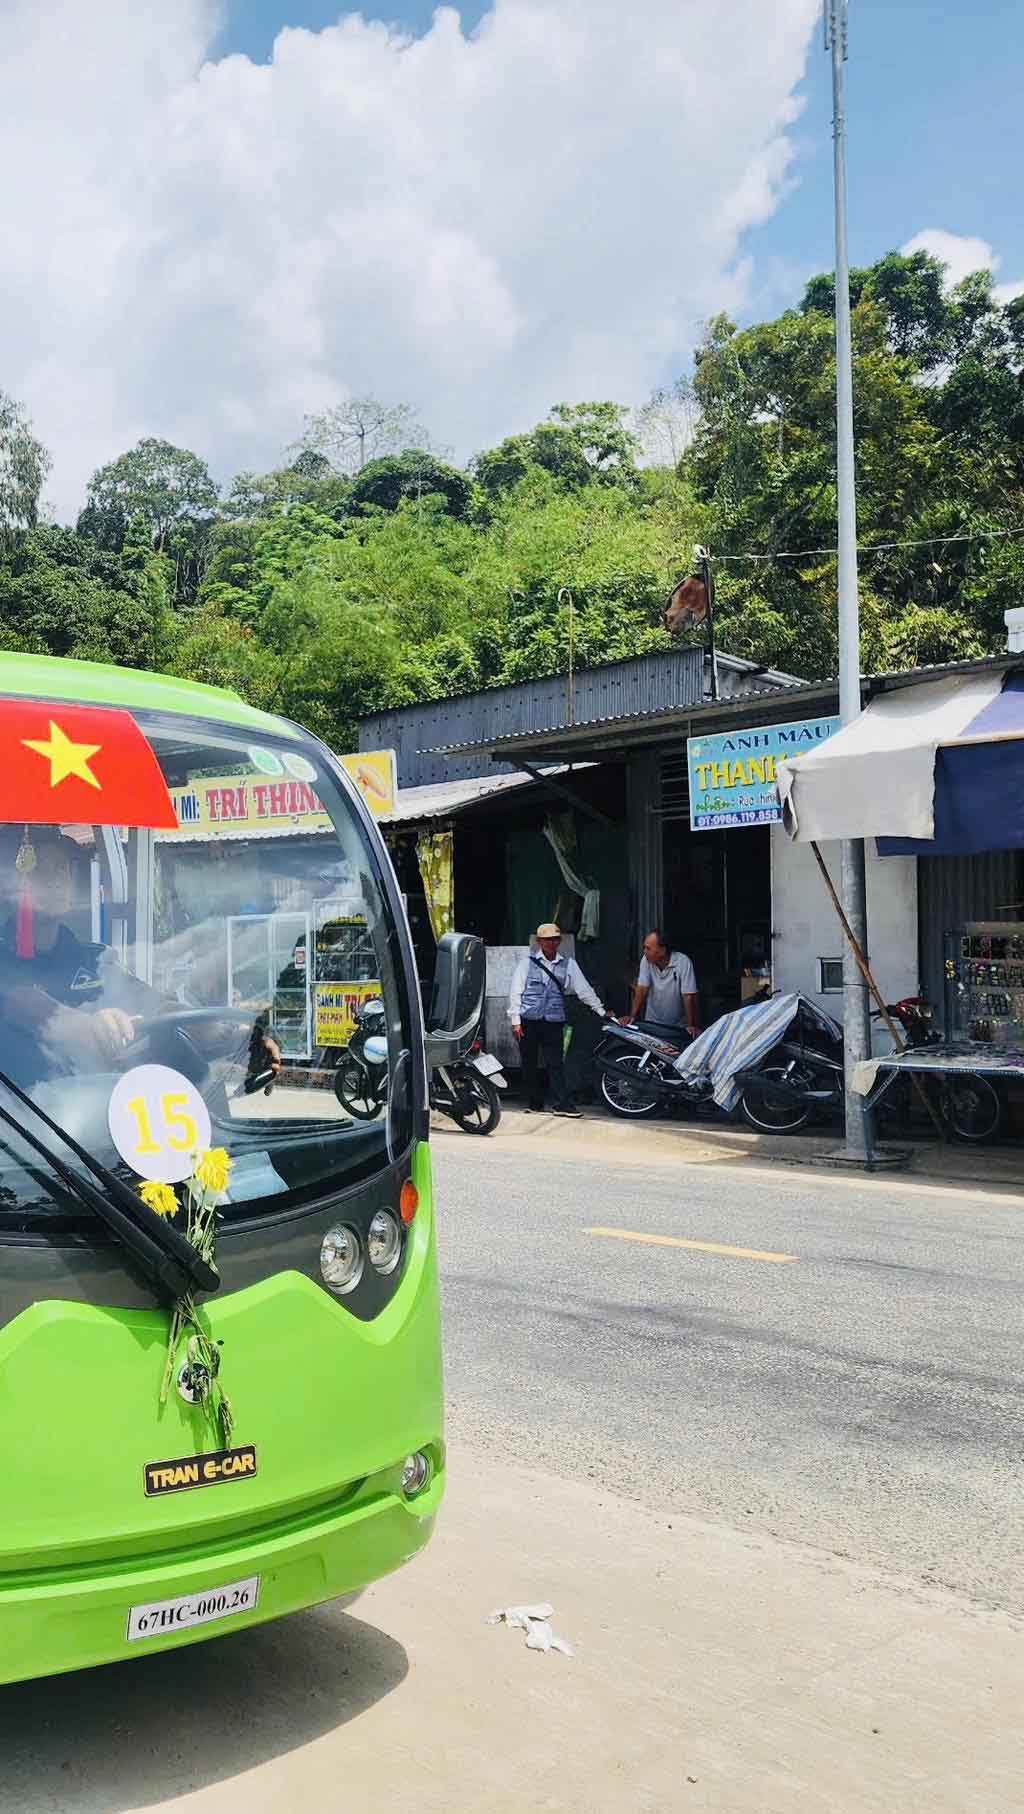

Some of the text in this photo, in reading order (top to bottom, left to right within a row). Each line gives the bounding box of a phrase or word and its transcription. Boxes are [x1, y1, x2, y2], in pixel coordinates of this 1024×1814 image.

[252, 781, 327, 826] THỊN
[127, 1092, 200, 1153] 15
[148, 1453, 256, 1489] TRAN E-CAR
[137, 1588, 250, 1631] 67HC-000.26
